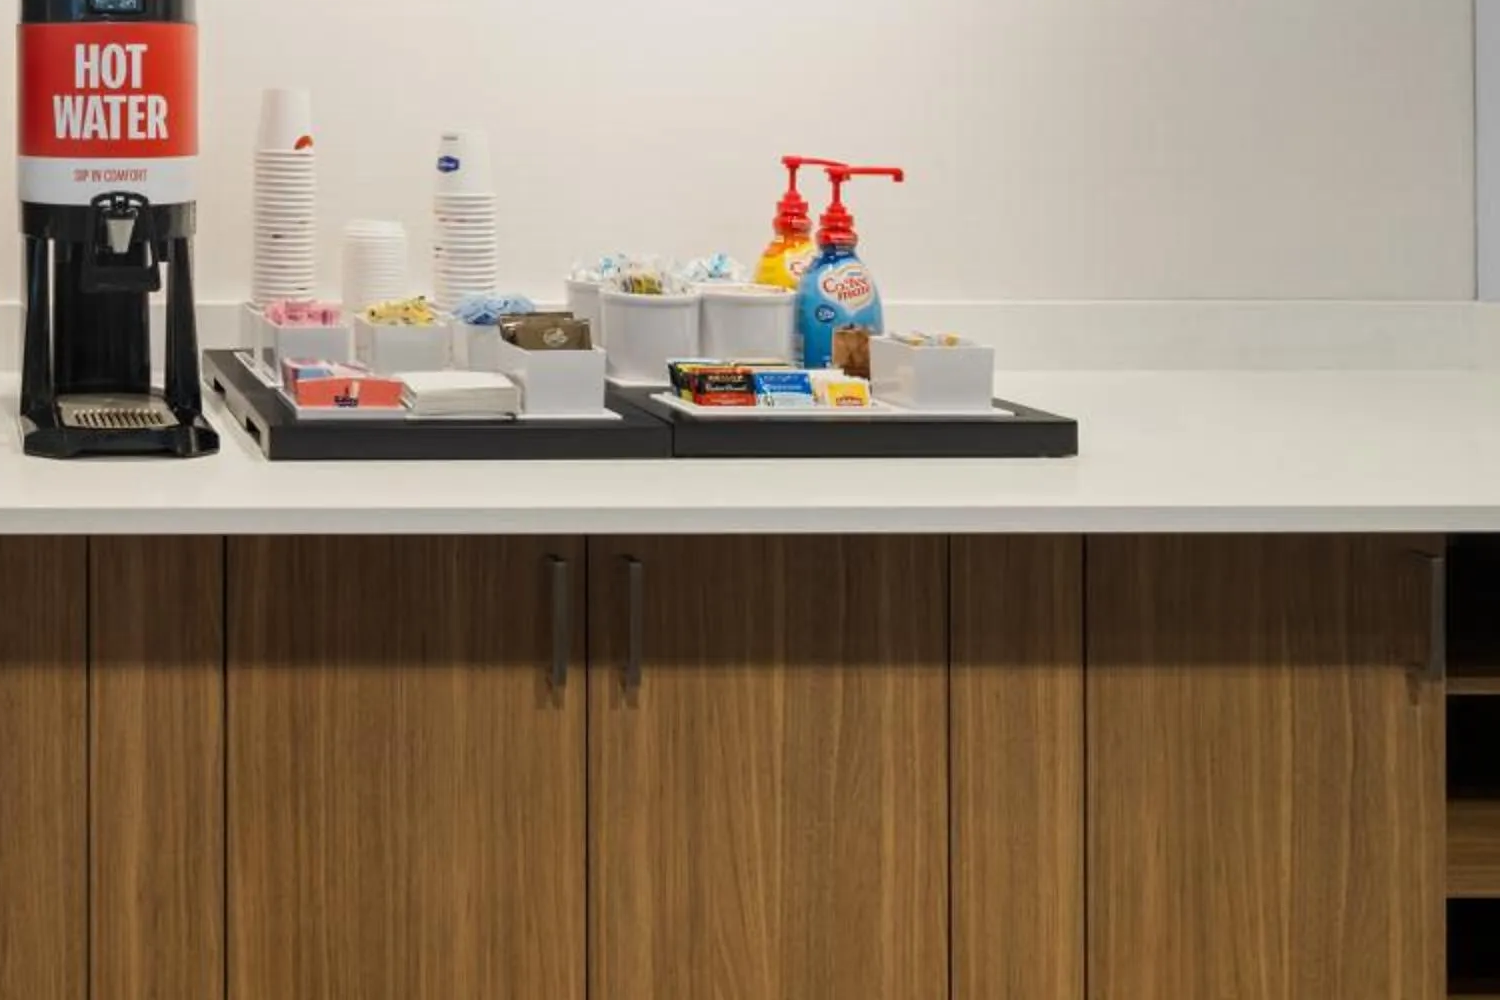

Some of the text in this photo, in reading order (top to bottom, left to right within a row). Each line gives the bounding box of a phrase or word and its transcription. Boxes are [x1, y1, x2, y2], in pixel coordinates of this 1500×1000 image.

[74, 43, 148, 89] HOT
[52, 95, 169, 140] WATER
[103, 168, 148, 182] COMFORT
